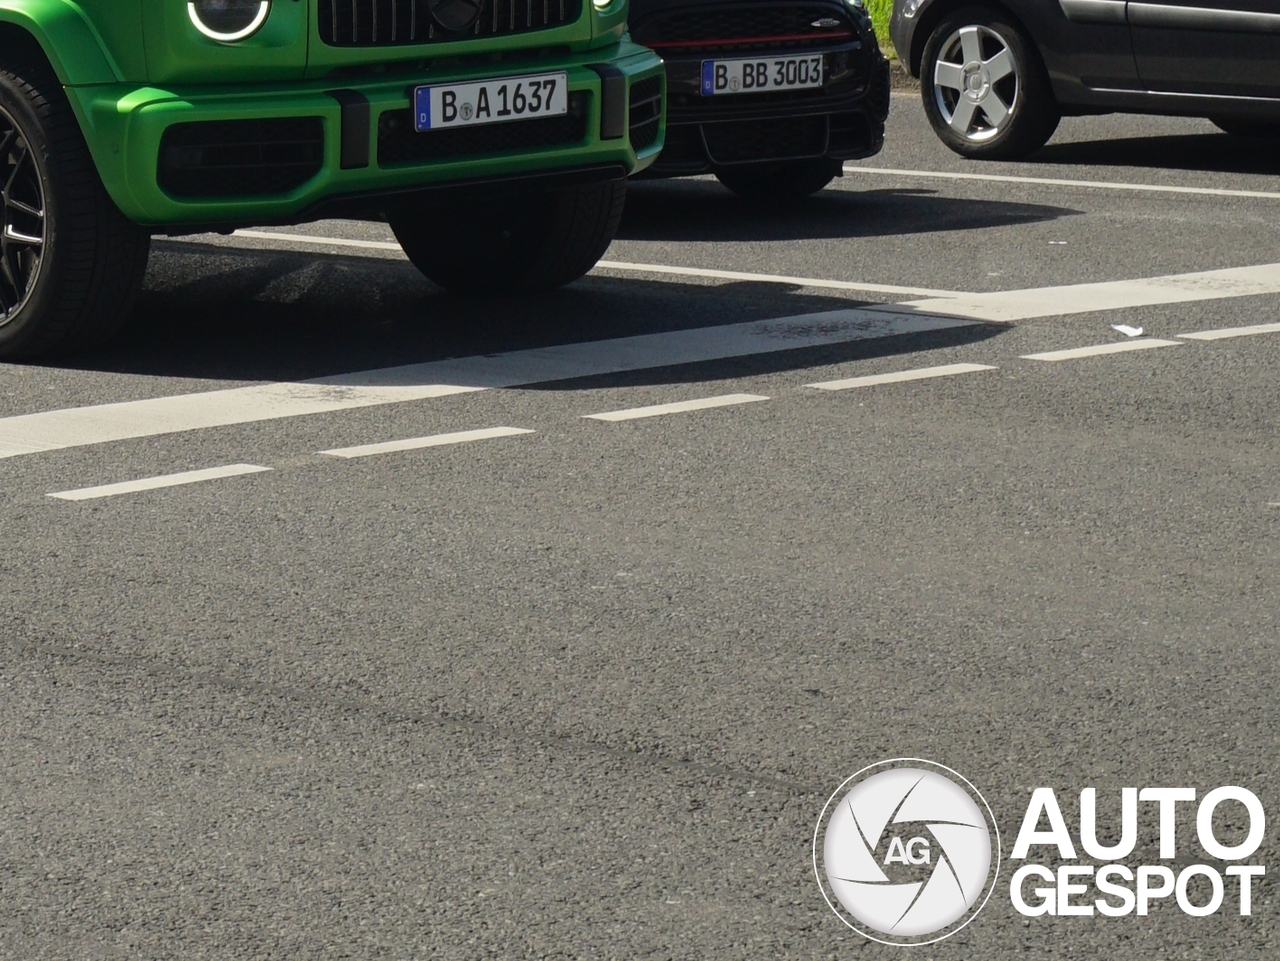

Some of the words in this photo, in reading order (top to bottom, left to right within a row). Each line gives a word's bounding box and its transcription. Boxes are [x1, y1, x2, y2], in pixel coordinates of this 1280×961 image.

[715, 65, 728, 90] B
[742, 62, 768, 88] BB
[773, 58, 820, 86] 3003
[442, 90, 457, 122] B
[476, 87, 491, 119] A
[497, 79, 557, 117] 1637
